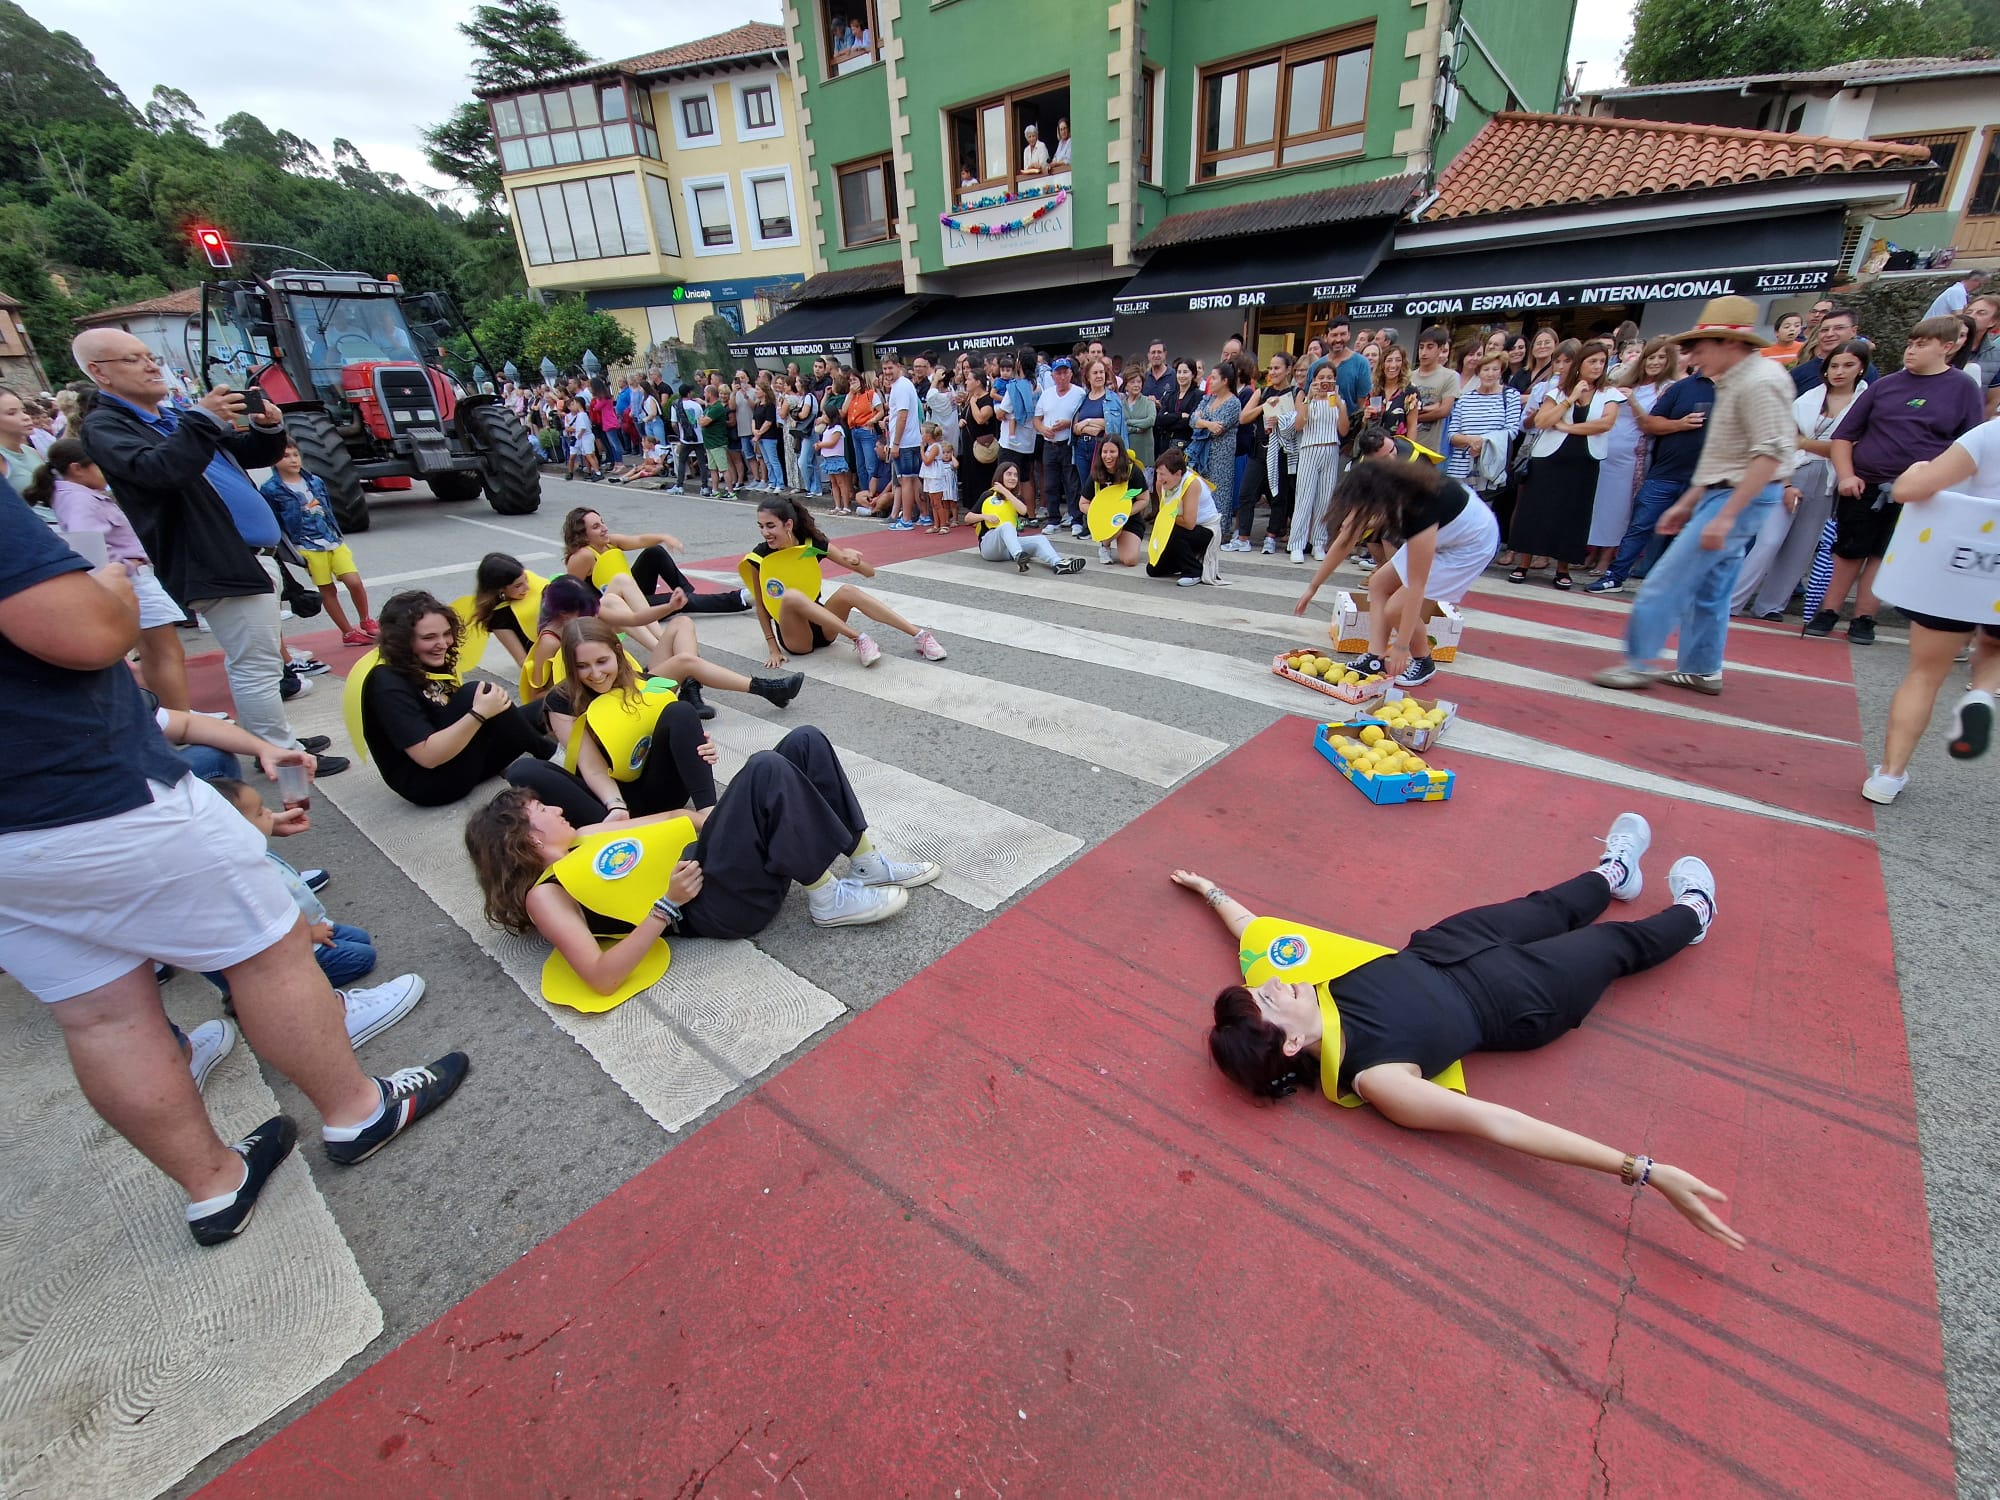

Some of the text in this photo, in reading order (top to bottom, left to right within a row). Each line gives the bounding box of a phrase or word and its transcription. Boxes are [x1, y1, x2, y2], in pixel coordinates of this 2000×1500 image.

[1756, 272, 1829, 287] KELER
[685, 289, 711, 300] Unicaja
[1313, 283, 1357, 297] KELER
[1189, 292, 1266, 310] BISTRO BAR
[1405, 299, 1463, 316] COCINA
[1471, 288, 1560, 311] ESPAÑOLA
[1580, 279, 1736, 303] INTERNACIONAL
[1115, 301, 1150, 312] KELER
[1348, 303, 1394, 316] KELER
[1078, 325, 1111, 336] KELER
[948, 335, 1014, 351] LA PARIENTUCA
[754, 344, 823, 356] COCINA DE MERCADO
